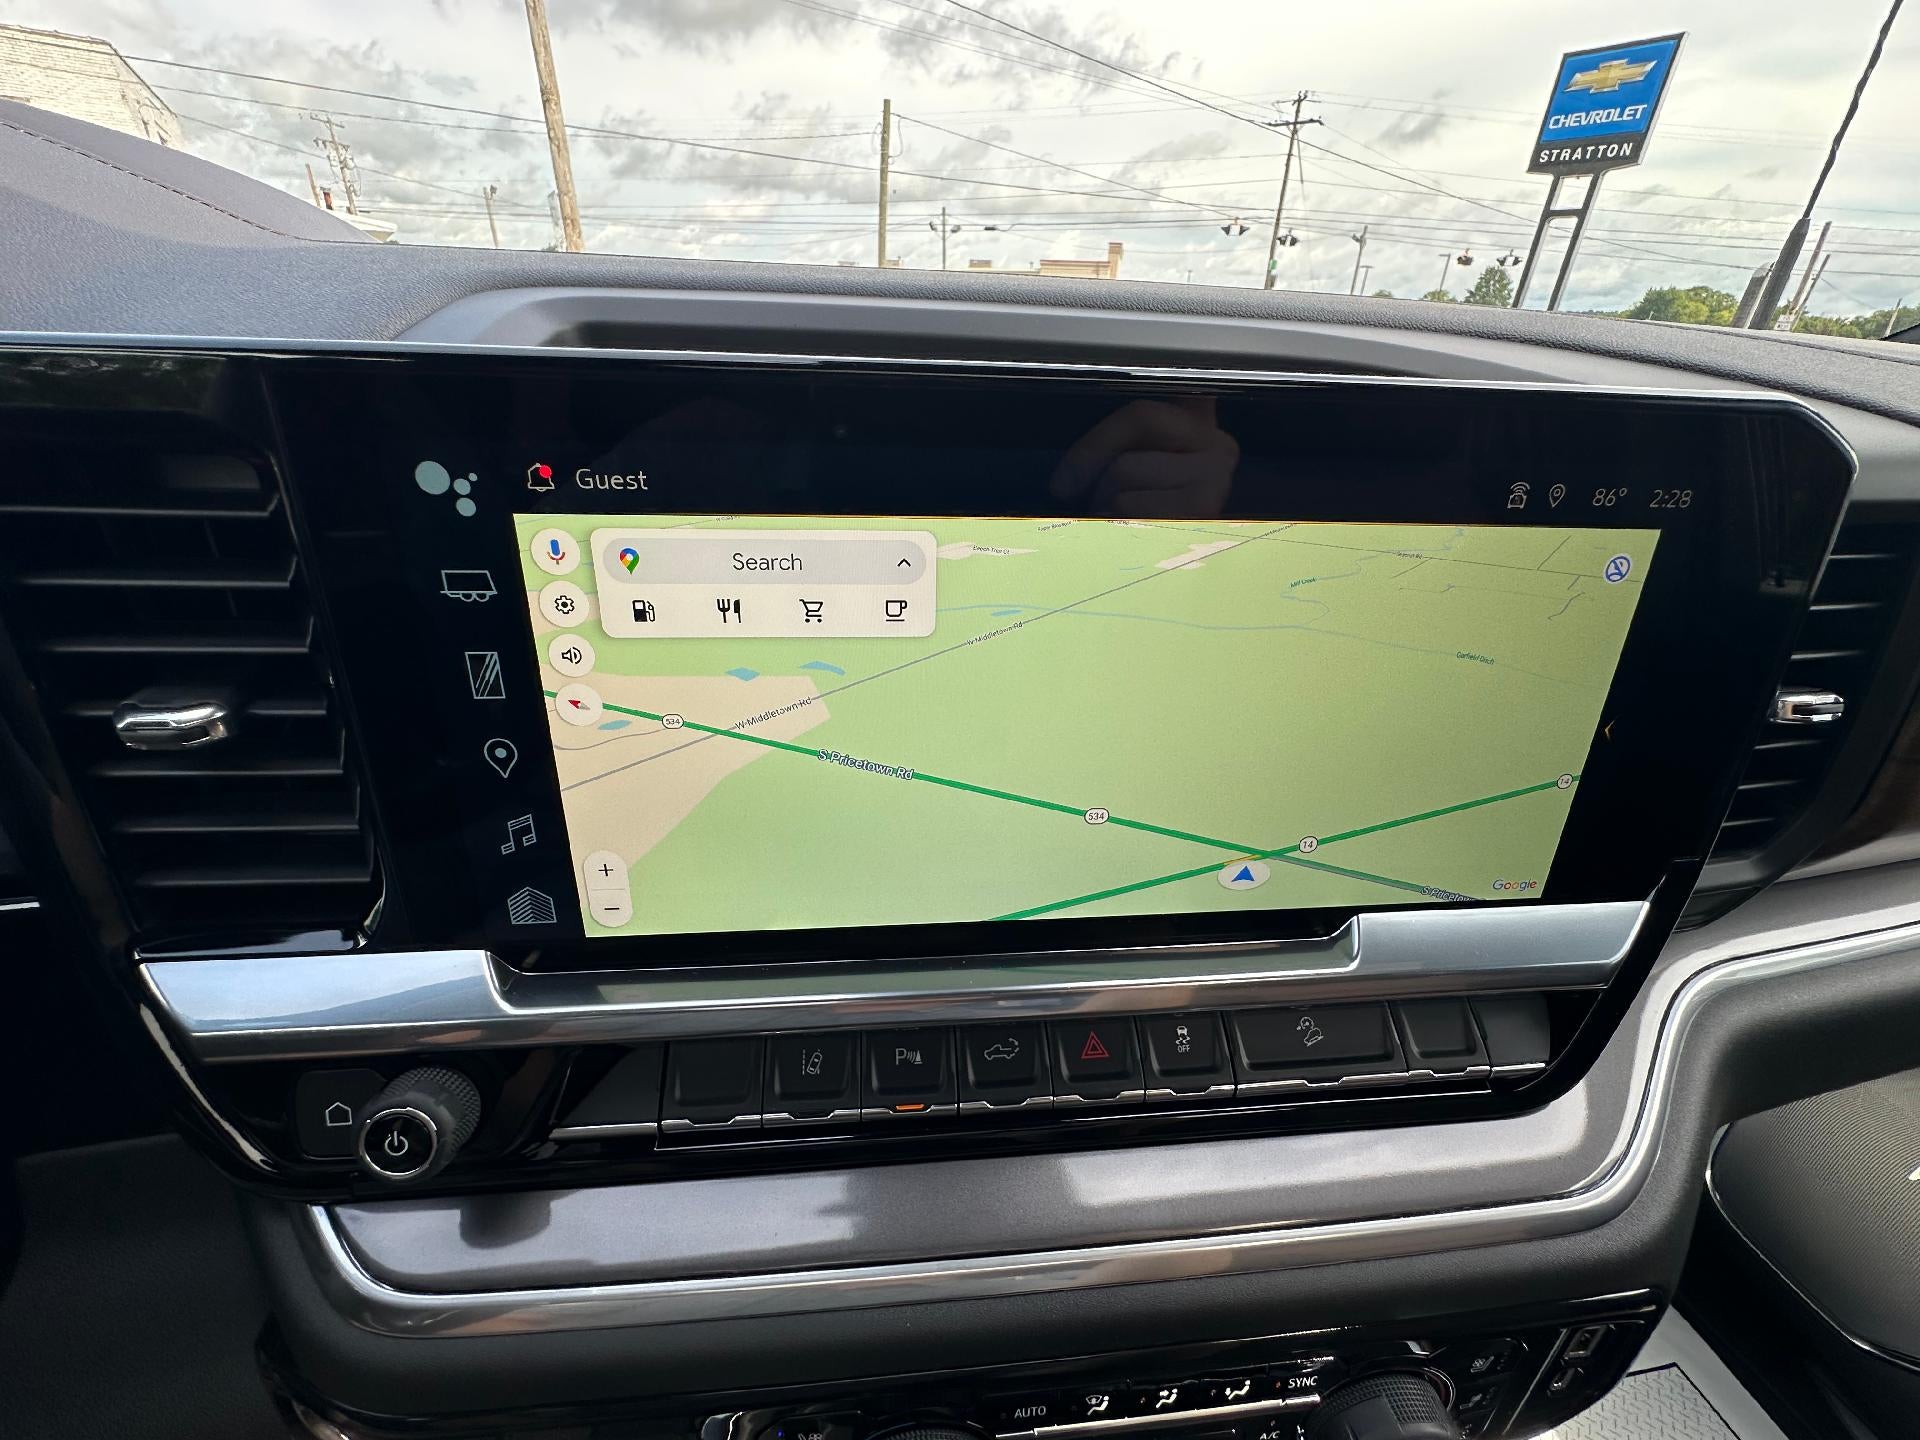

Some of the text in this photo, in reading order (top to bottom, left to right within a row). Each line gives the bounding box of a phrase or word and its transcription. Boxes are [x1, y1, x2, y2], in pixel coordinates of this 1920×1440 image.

[1549, 104, 1647, 129] CHEVROLET
[1539, 142, 1633, 162] STRATTON
[576, 468, 648, 490] Guest
[1650, 489, 1693, 508] 2:28
[732, 552, 803, 572] Search
[735, 696, 812, 730] W Middletown Rd
[665, 717, 681, 726] 534
[817, 749, 914, 781] S Pricetown Rd
[1088, 812, 1105, 821] 534
[1303, 839, 1314, 849] 14
[1421, 886, 1431, 895] S
[1492, 878, 1537, 891] Google
[1177, 1044, 1190, 1053] OFF
[1288, 1376, 1318, 1389] SYNC
[1014, 1405, 1046, 1419] AUTO
[1260, 1430, 1280, 1440] A/C
